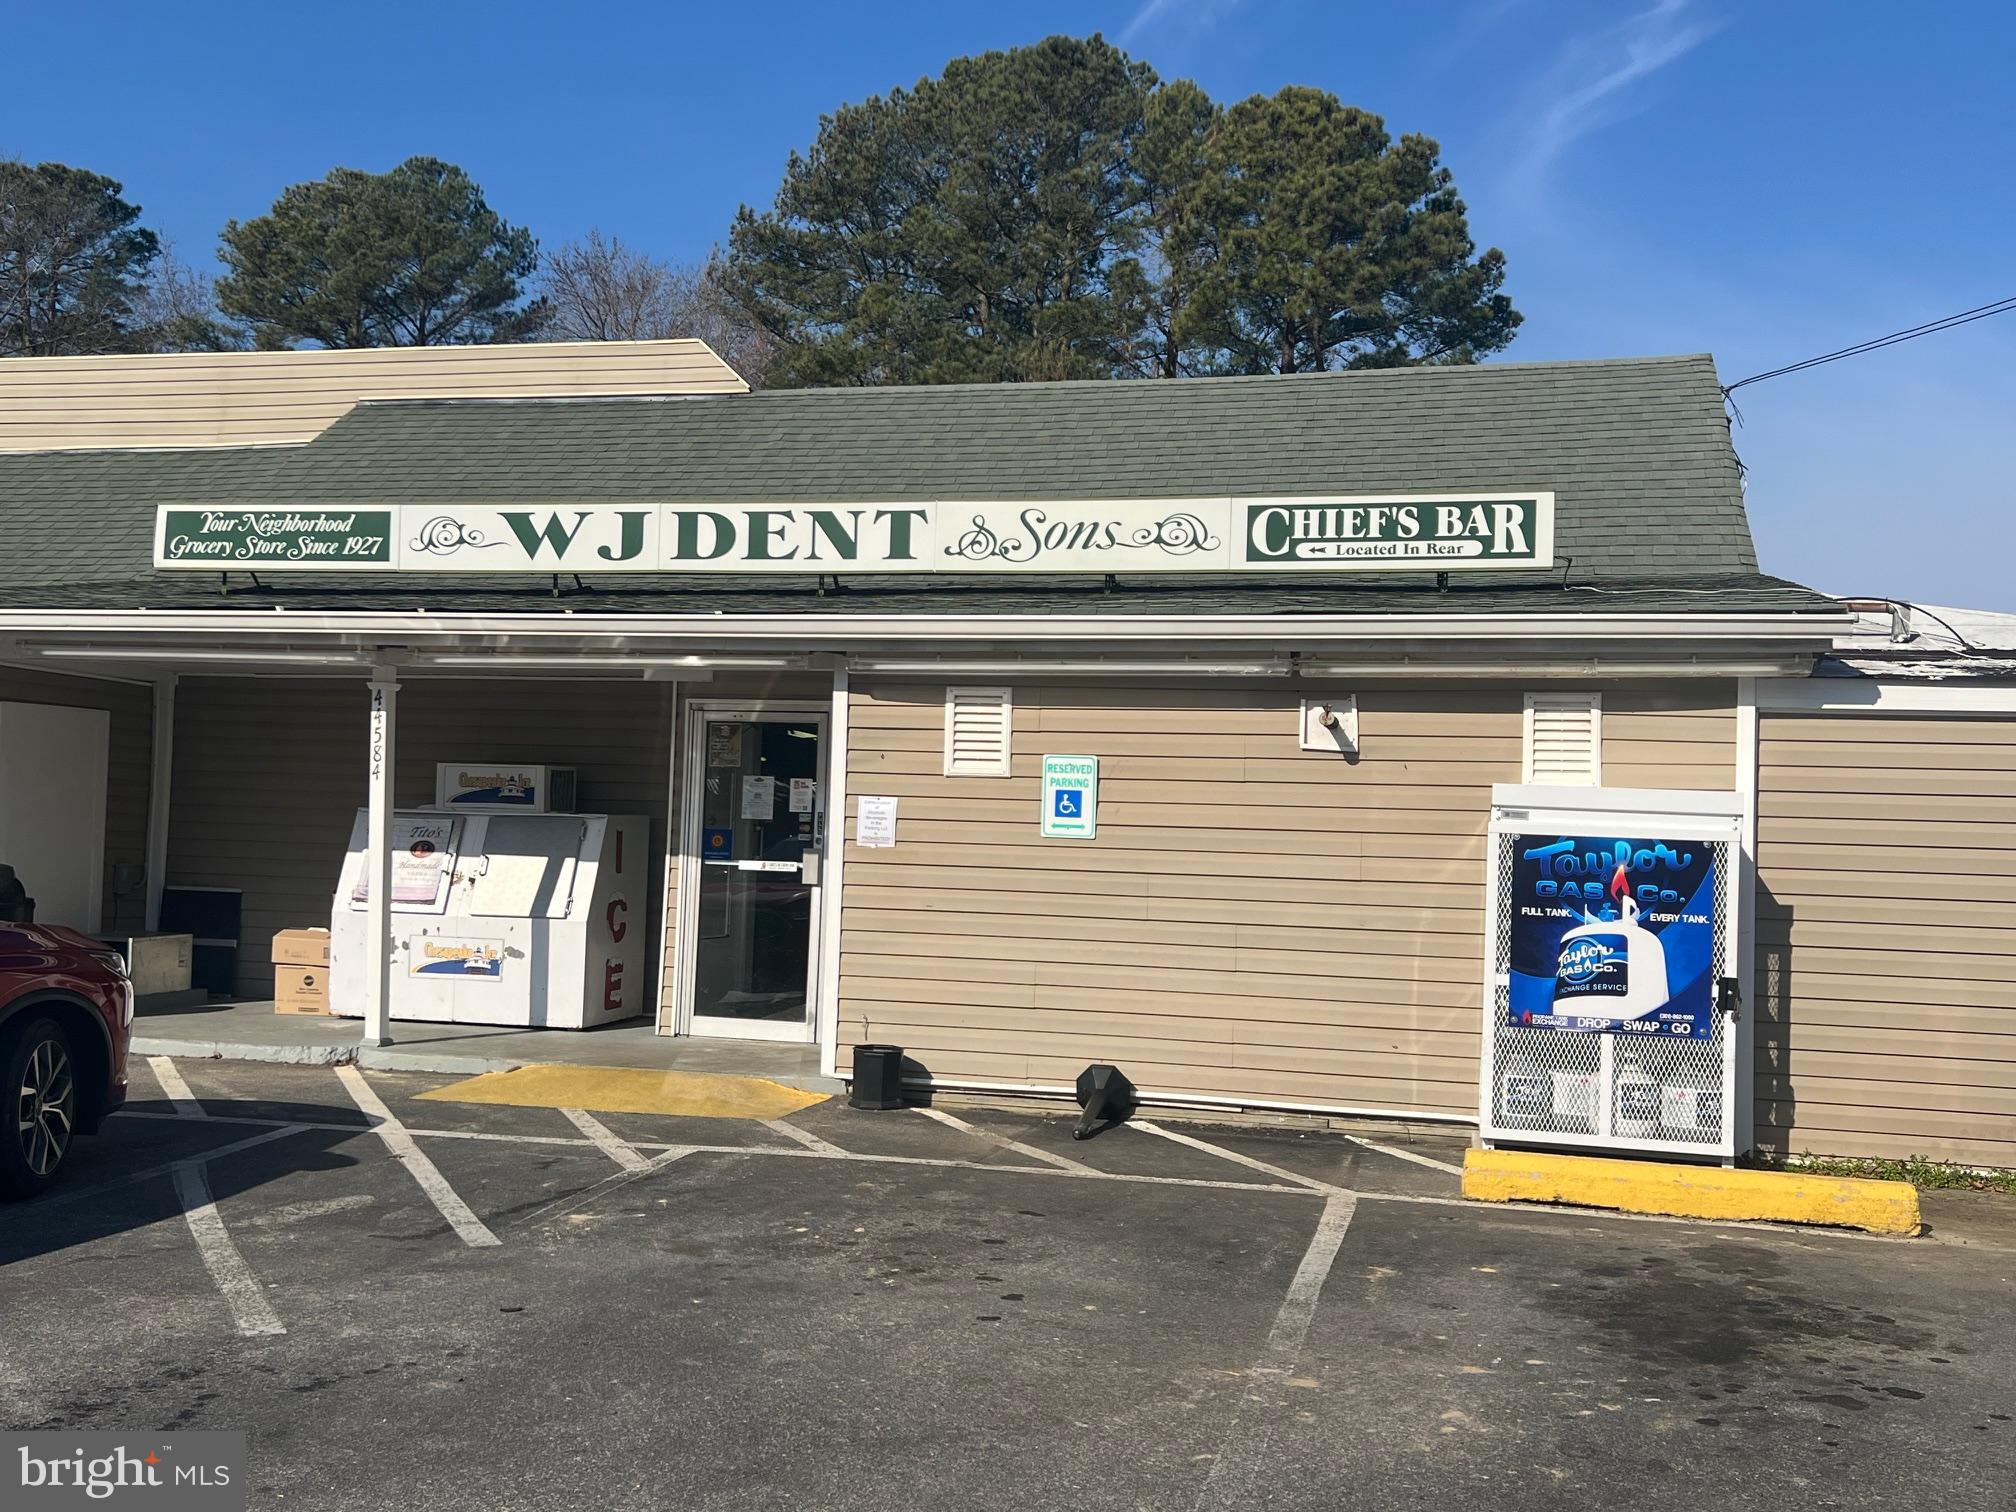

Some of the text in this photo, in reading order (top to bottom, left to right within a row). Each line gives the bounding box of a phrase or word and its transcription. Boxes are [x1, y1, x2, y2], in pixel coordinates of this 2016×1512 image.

[200, 512, 356, 537] Your Neighborhood
[1252, 503, 1530, 556] CHIEF'S BAR
[669, 508, 930, 562] DENT
[1000, 507, 1123, 563] Sons
[170, 535, 384, 560] Grocery Store Since 1927
[1335, 542, 1464, 556] Located In Rear
[371, 688, 383, 780] 44584
[1047, 763, 1093, 774] RESERVED
[1050, 777, 1089, 788] PARKING
[410, 825, 443, 839] Tito's
[1524, 840, 1692, 885] Taylor
[1536, 880, 1686, 903] GAS Co.
[604, 827, 628, 1011] ICE
[1521, 906, 1572, 918] FULL TANK.
[1650, 913, 1710, 924] EVERY TANK.
[1558, 944, 1614, 966] Taylor
[1560, 963, 1618, 978] GAS Co.
[1593, 983, 1627, 992] SERVICE
[1532, 1018, 1569, 1027] EXCHANGE
[1577, 1017, 1611, 1029] DROP
[1623, 1020, 1660, 1032] SWAP
[1671, 1023, 1691, 1034] GO
